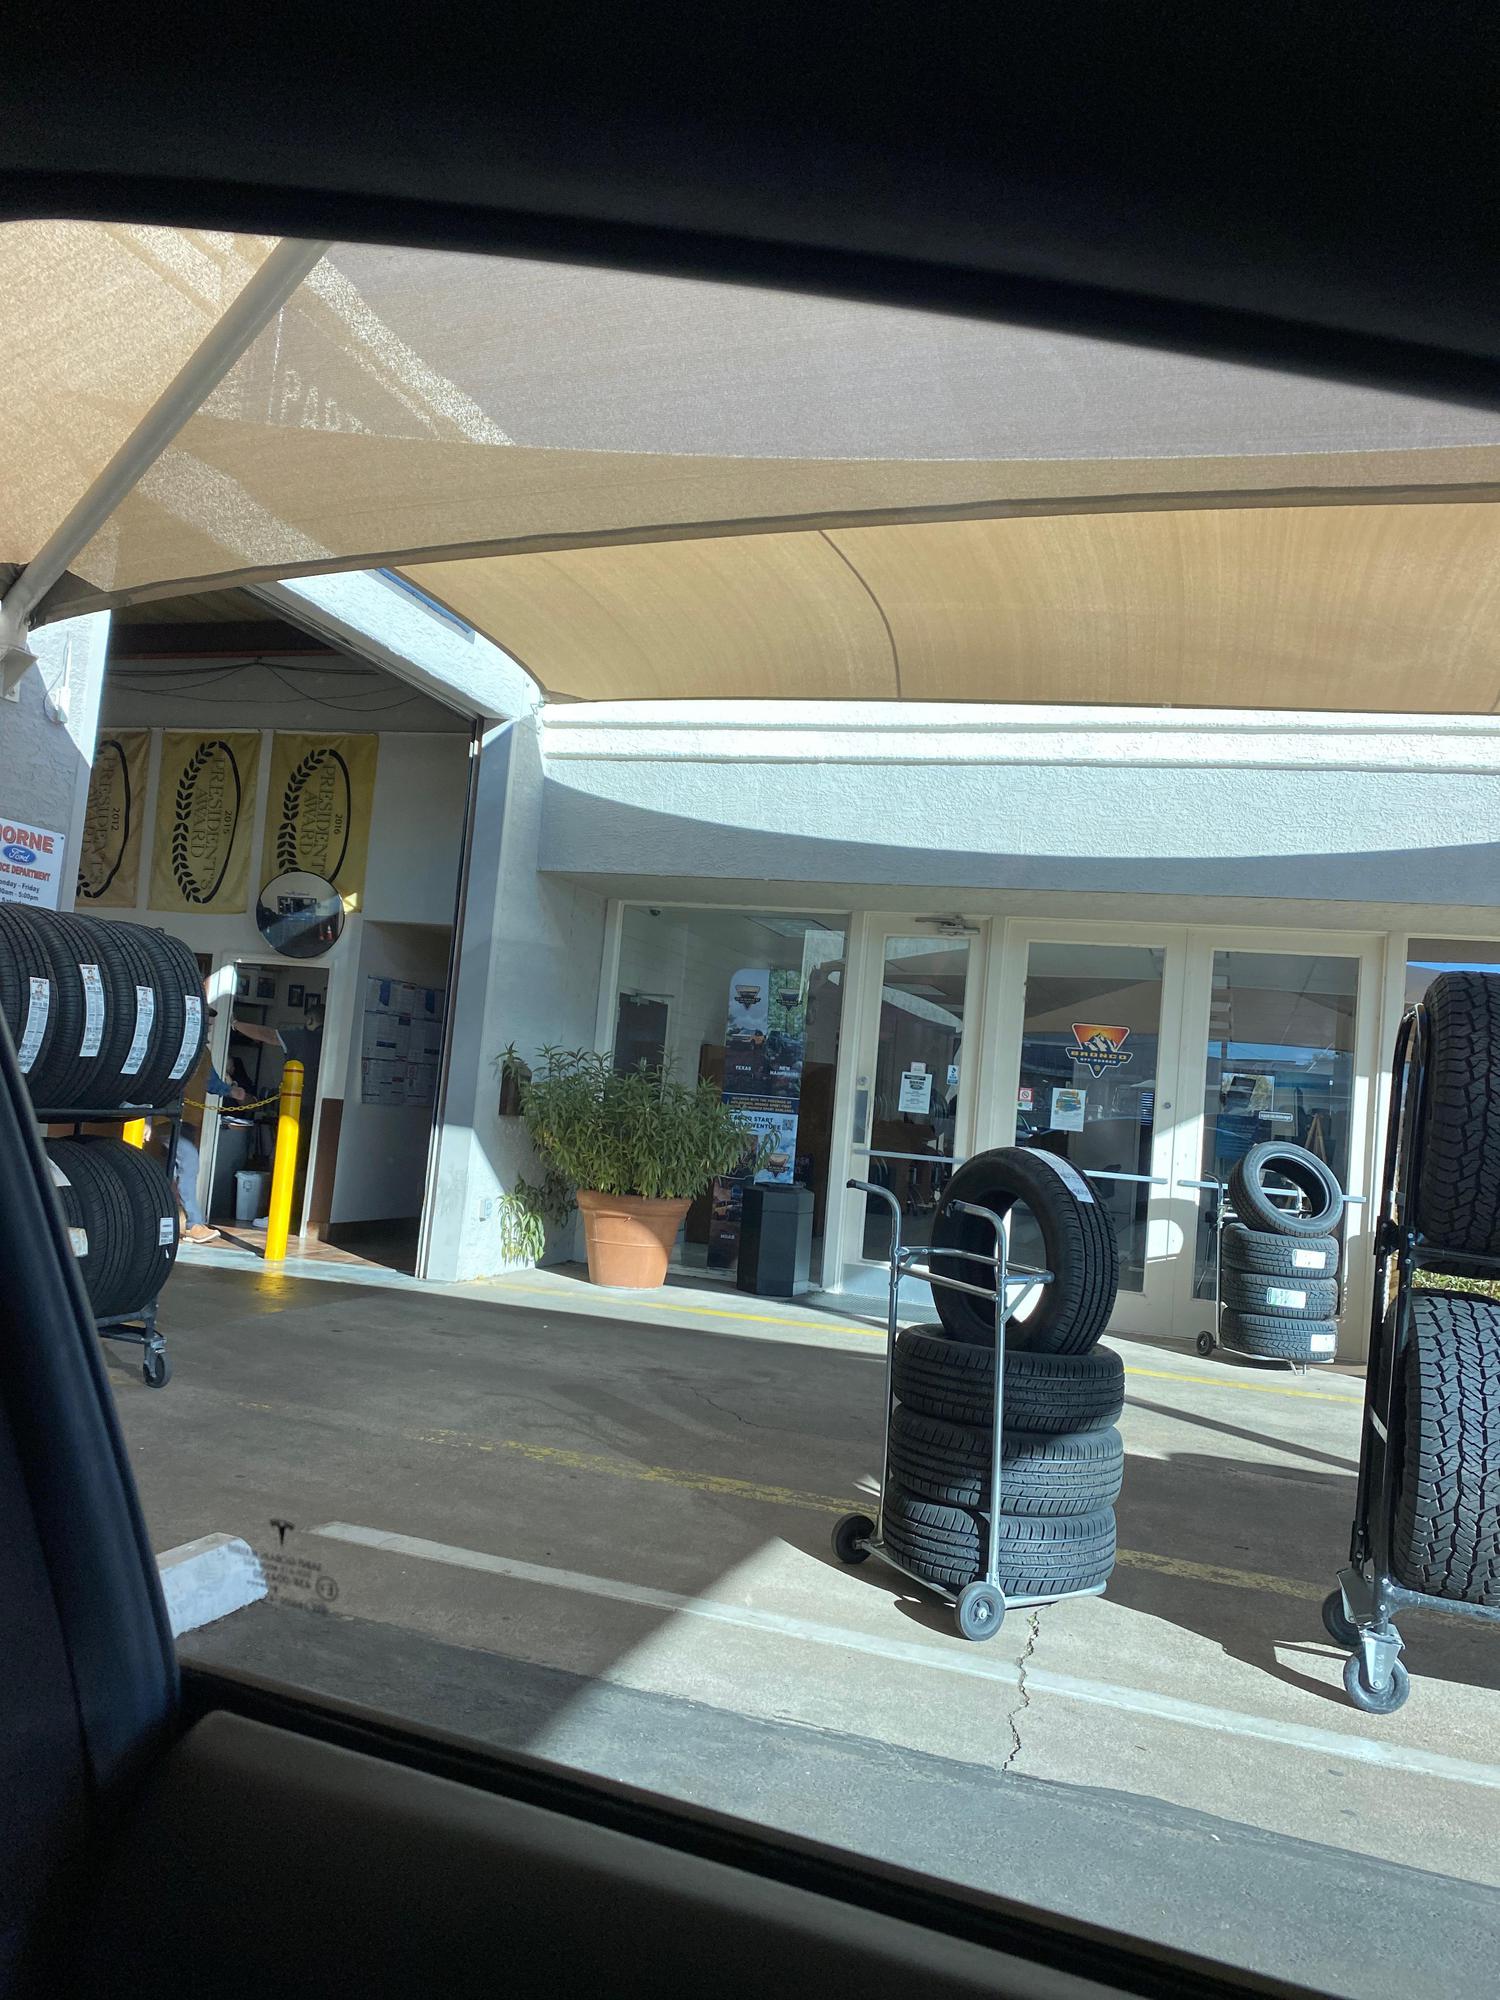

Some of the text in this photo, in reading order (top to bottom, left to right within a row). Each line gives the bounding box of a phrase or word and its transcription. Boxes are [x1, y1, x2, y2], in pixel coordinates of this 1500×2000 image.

[111, 807, 121, 831] 2012
[191, 787, 208, 858] AWARD
[200, 757, 226, 891] PRESIDENT'S
[300, 789, 318, 856] AWARD
[311, 764, 337, 877] PRESIDENT'
[333, 813, 343, 835] 2016
[8, 848, 30, 862] Ford
[11, 865, 50, 881] DEPARTMENT
[22, 882, 40, 894] Friday
[1071, 1051, 1127, 1060] BRONCO
